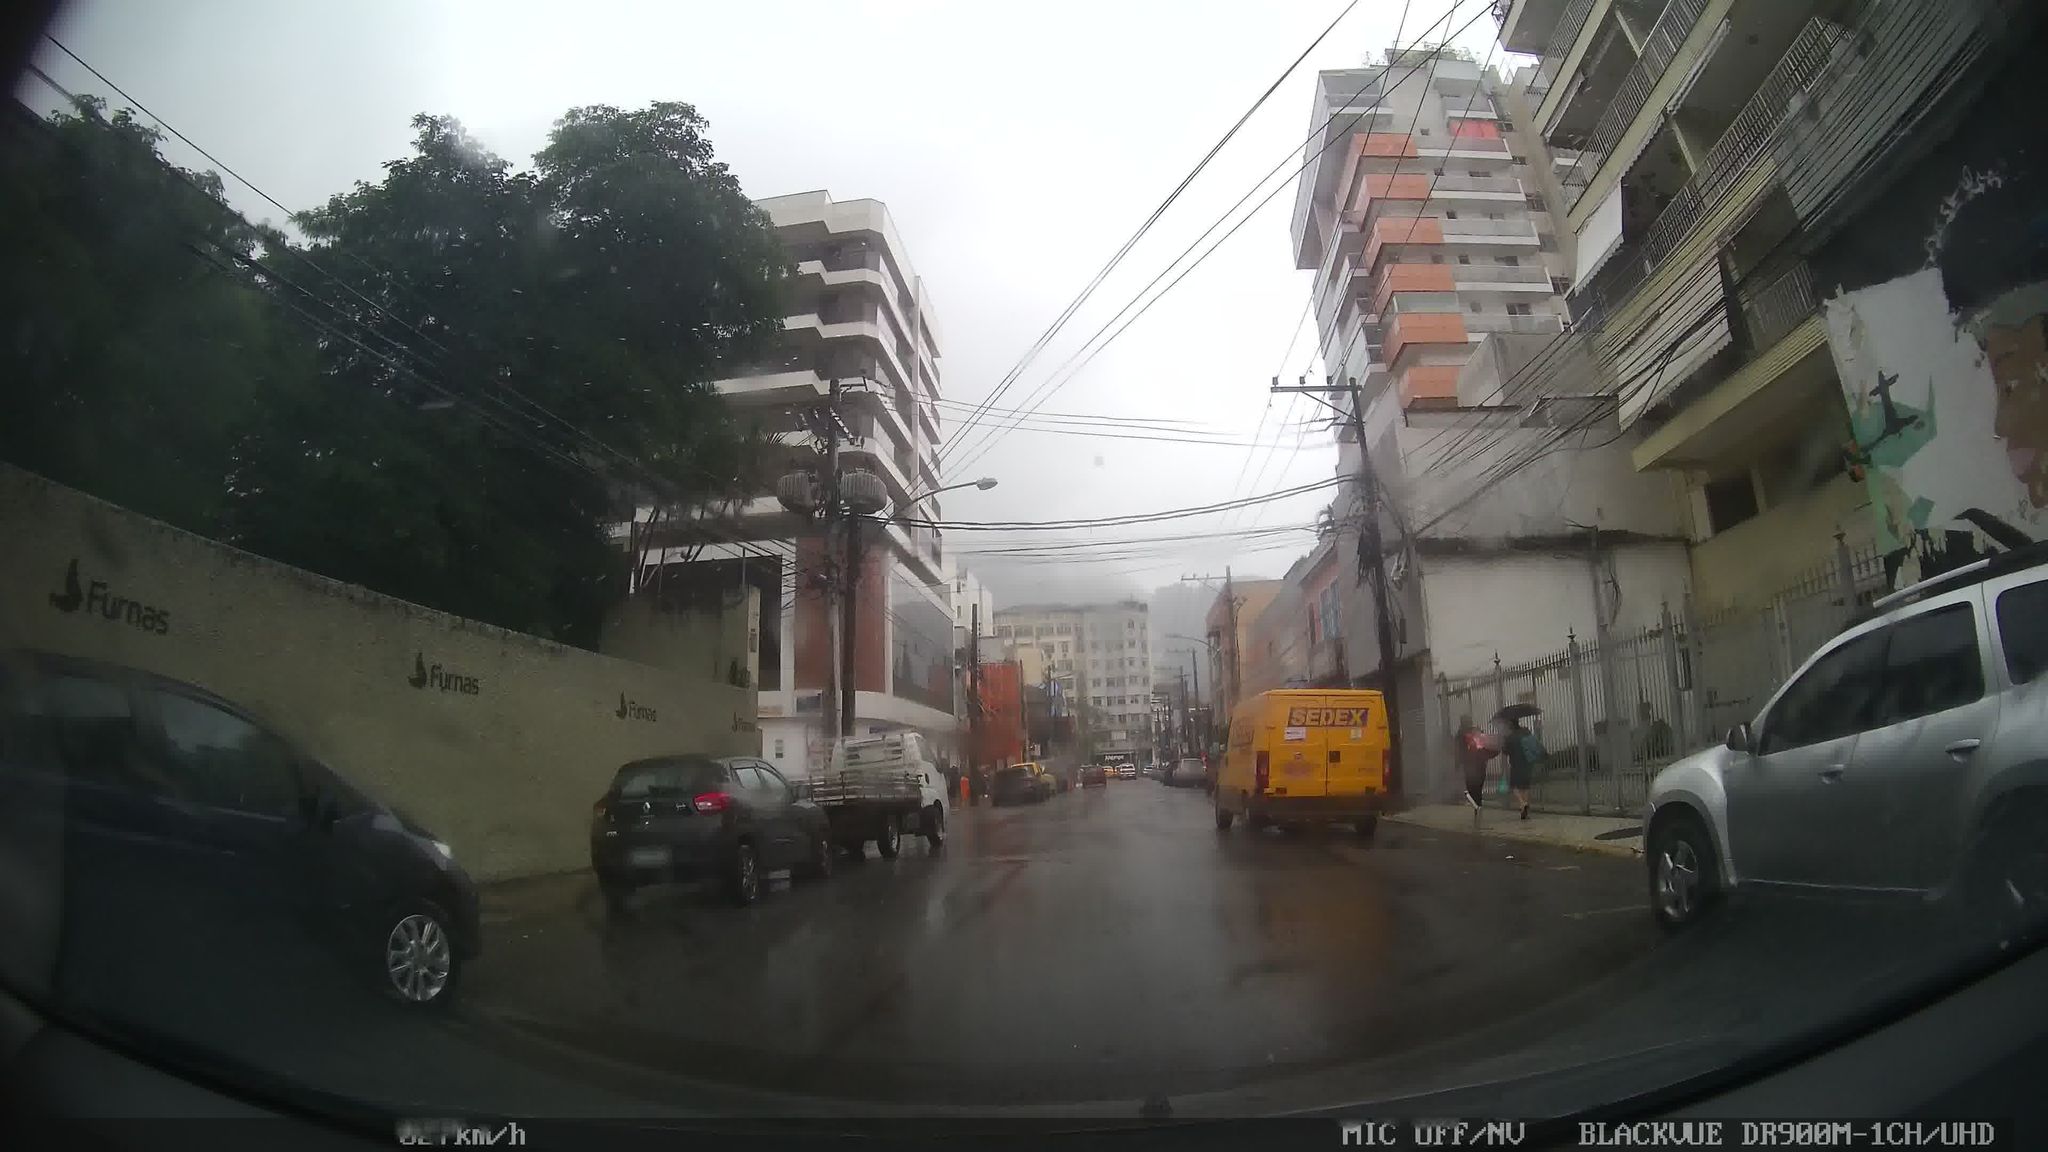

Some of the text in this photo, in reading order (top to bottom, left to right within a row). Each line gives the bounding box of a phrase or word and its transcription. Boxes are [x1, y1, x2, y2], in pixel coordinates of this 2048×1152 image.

[87, 579, 170, 636] Furnas
[430, 664, 479, 695] Furnas
[1290, 708, 1367, 726] SEDEX
